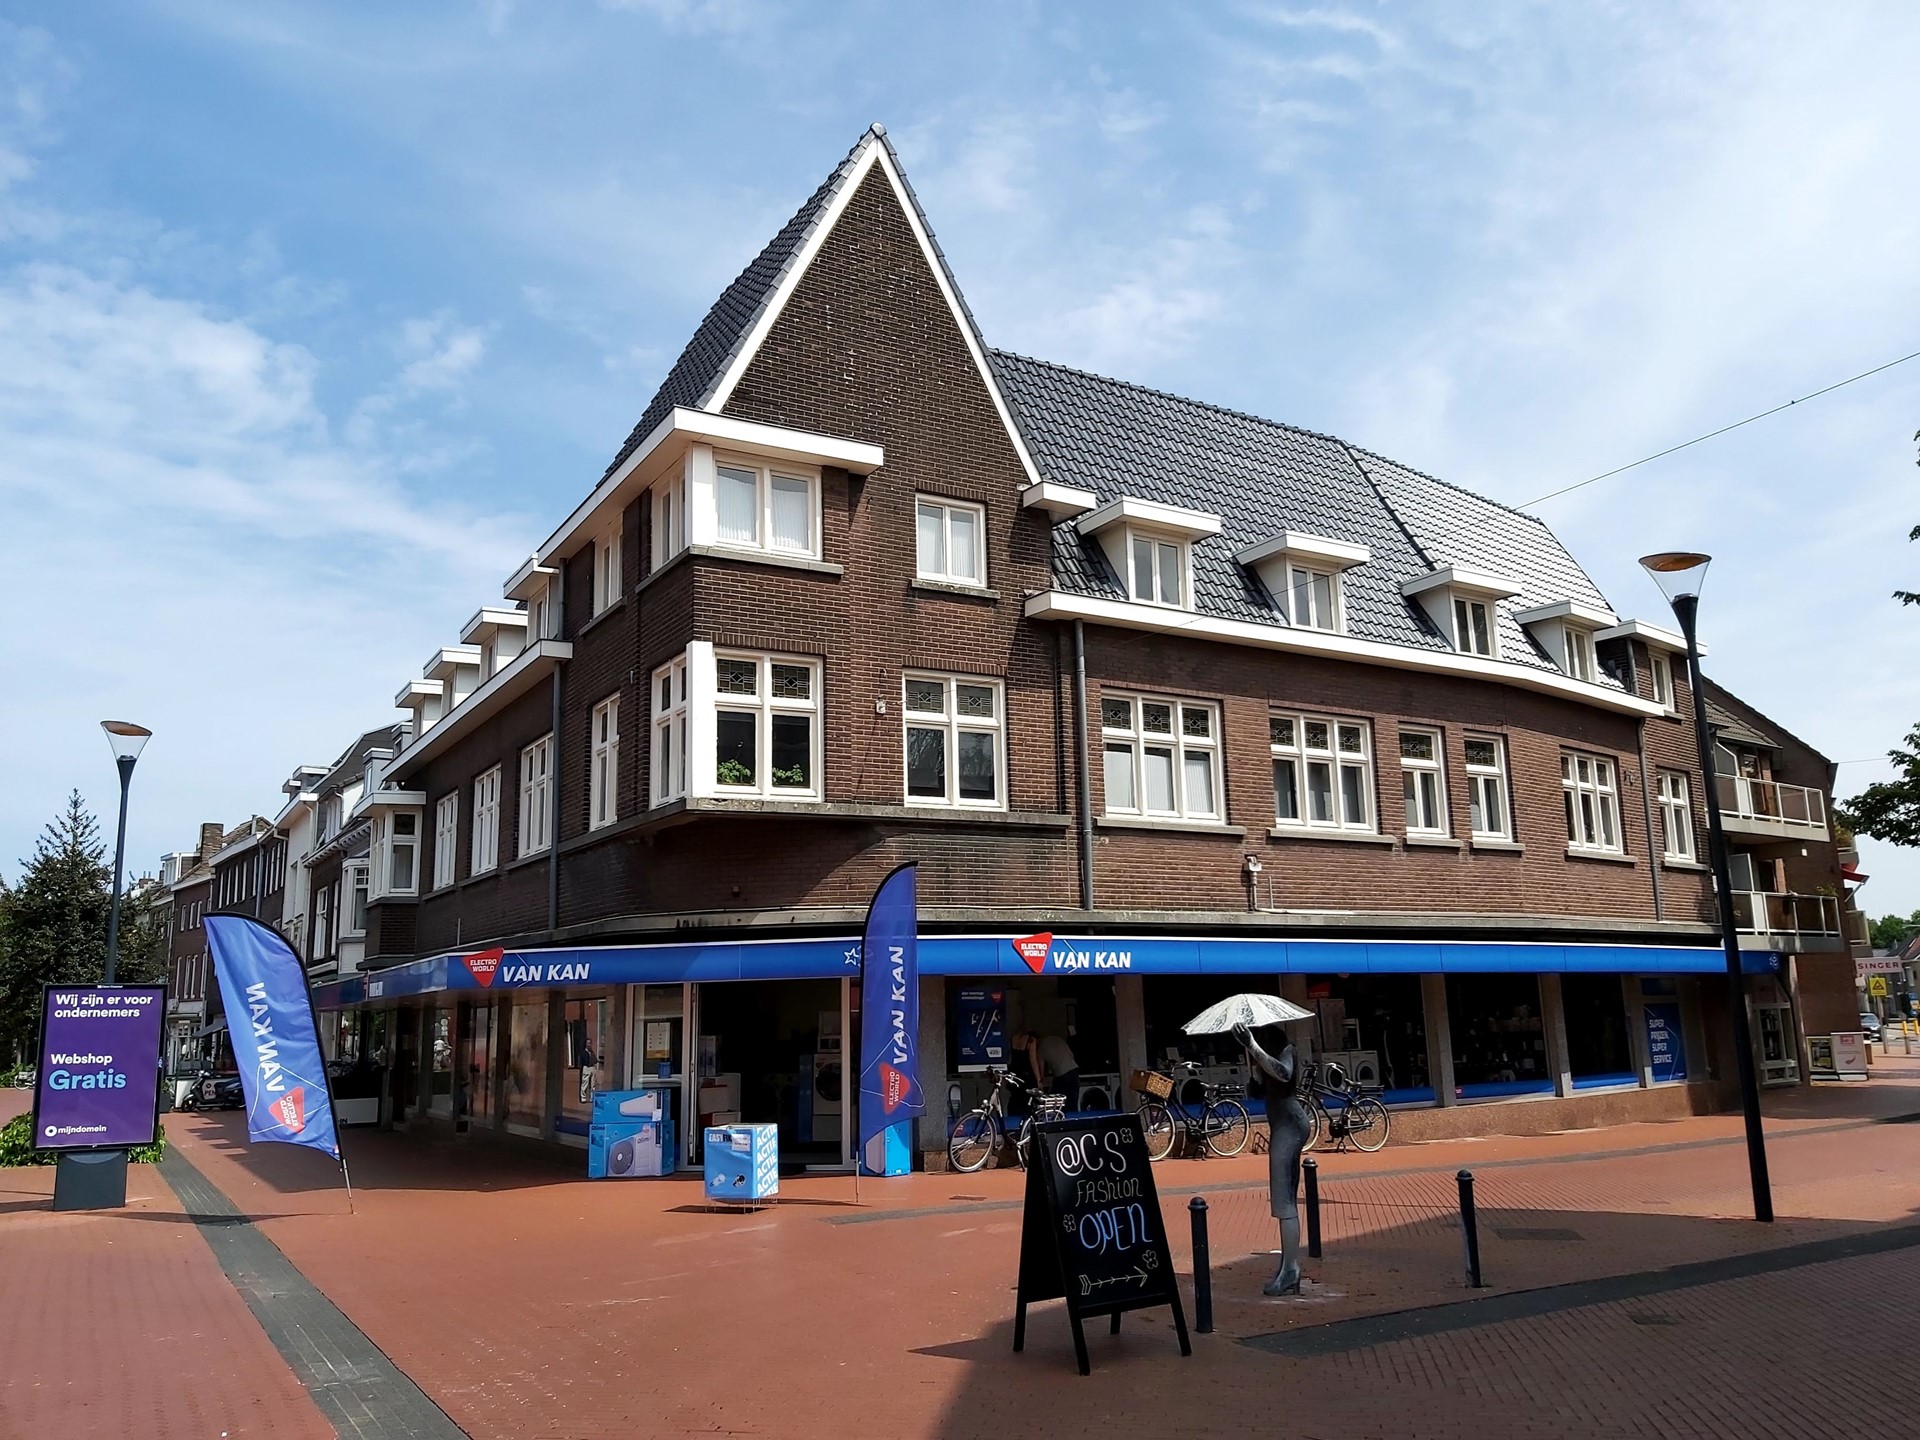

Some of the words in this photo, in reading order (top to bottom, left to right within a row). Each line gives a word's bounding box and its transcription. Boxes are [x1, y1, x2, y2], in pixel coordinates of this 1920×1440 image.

[470, 958, 497, 966] ELECTRO
[1053, 951, 1090, 968] VAN
[1094, 951, 1131, 968] KAN
[503, 965, 542, 982] VAN
[547, 963, 590, 981] KAN
[888, 945, 906, 1002] KAN
[55, 994, 78, 1007] Wij
[81, 994, 103, 1007] zijn
[107, 996, 121, 1005] er
[124, 996, 153, 1005] voor
[54, 1007, 140, 1018] ondernemers
[890, 1010, 908, 1065] VAN
[1652, 1042, 1667, 1052] SUPER
[50, 1053, 112, 1066] Webshop
[48, 1068, 127, 1090] Gratis
[893, 1073, 901, 1102] WORLD
[58, 1125, 107, 1135] mijndomein
[757, 1136, 777, 1165] ACTIE
[757, 1152, 777, 1180] ACTIE
[757, 1167, 778, 1196] ACTIE
